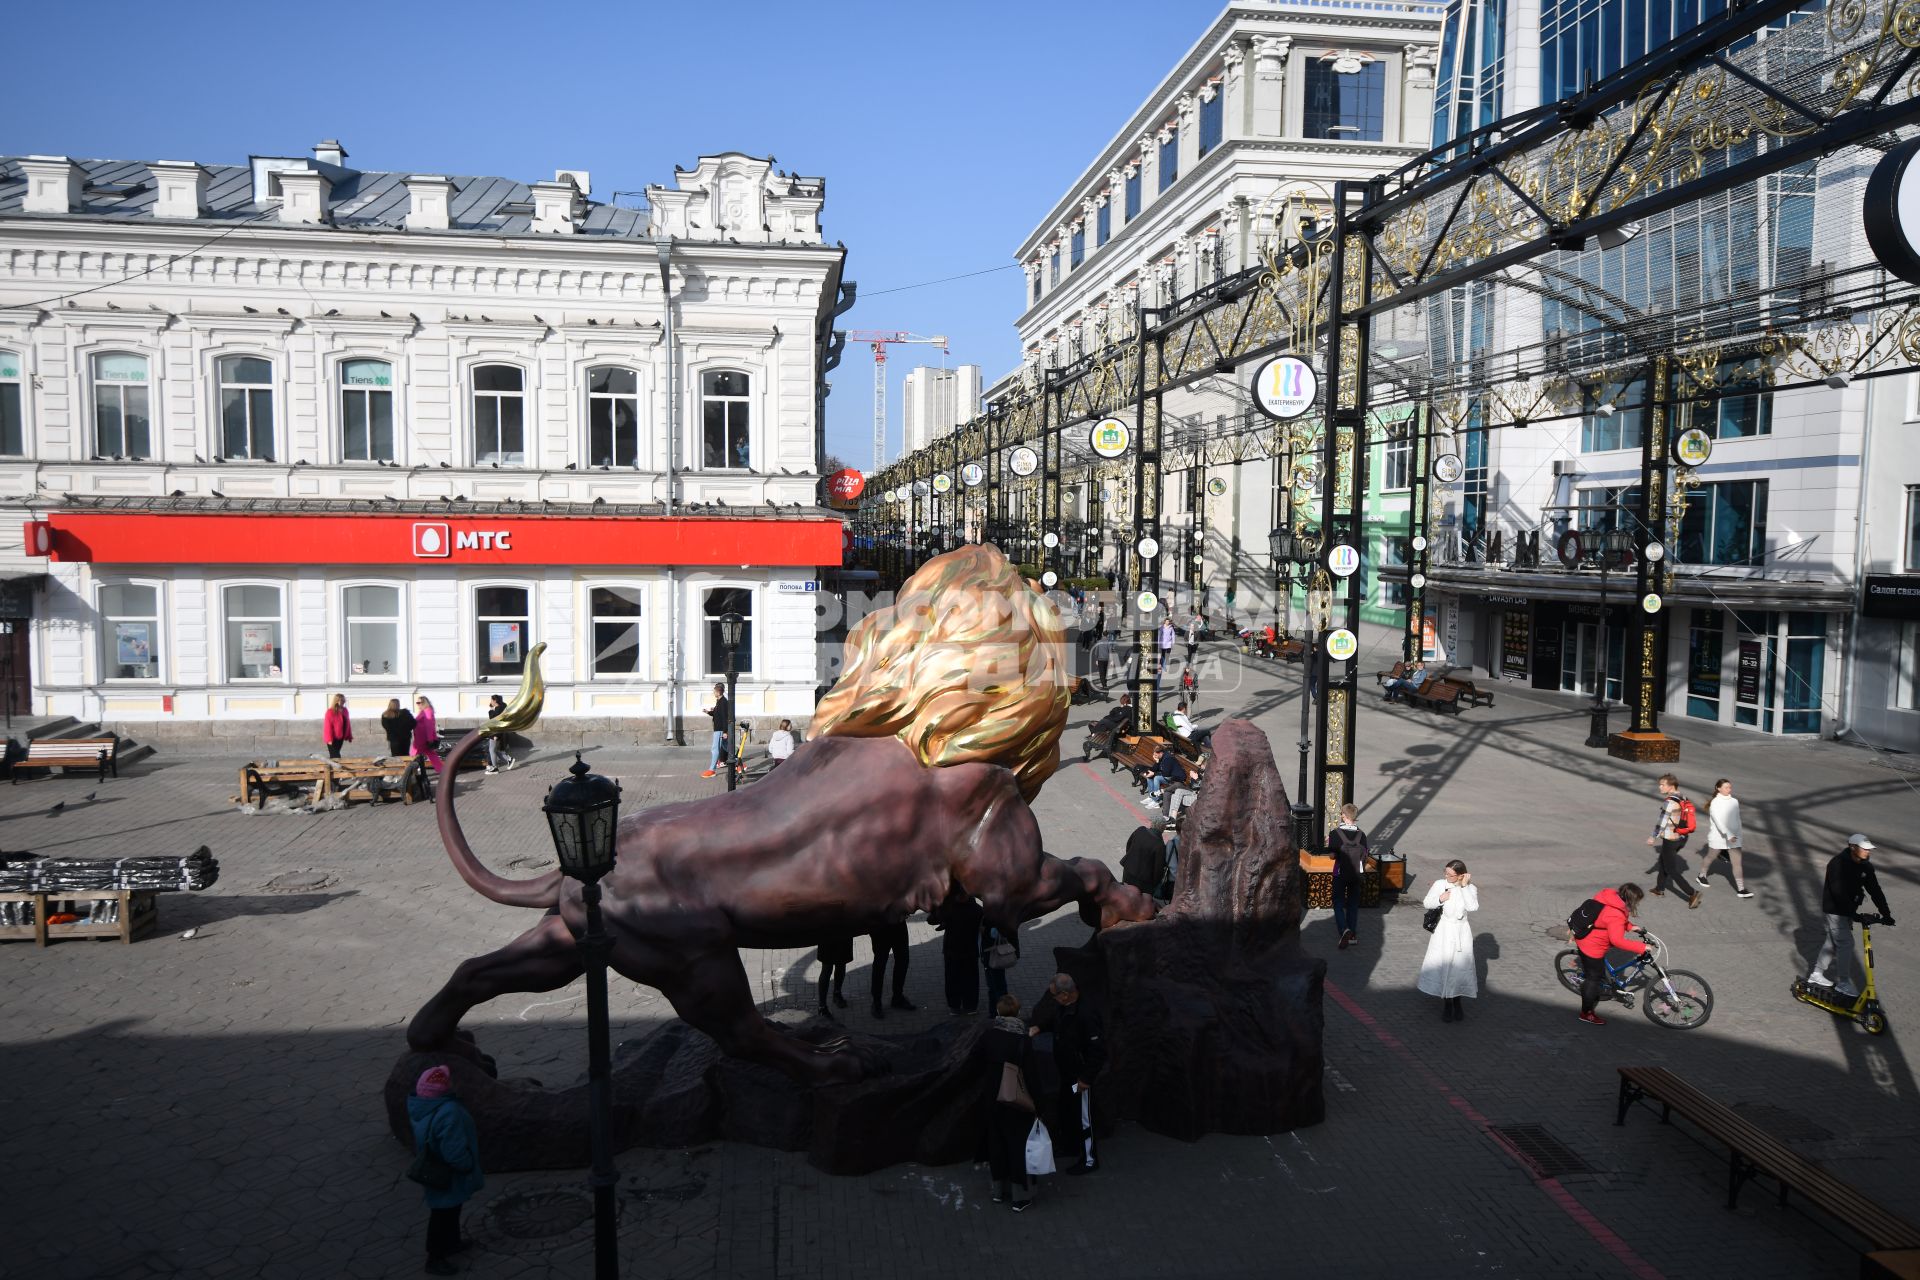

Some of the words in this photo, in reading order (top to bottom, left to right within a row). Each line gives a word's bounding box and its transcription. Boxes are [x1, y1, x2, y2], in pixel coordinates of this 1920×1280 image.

[350, 376, 374, 384] Tiens
[456, 531, 511, 550] МТС
[806, 582, 813, 591] 2
[1870, 584, 1897, 595] Салон
